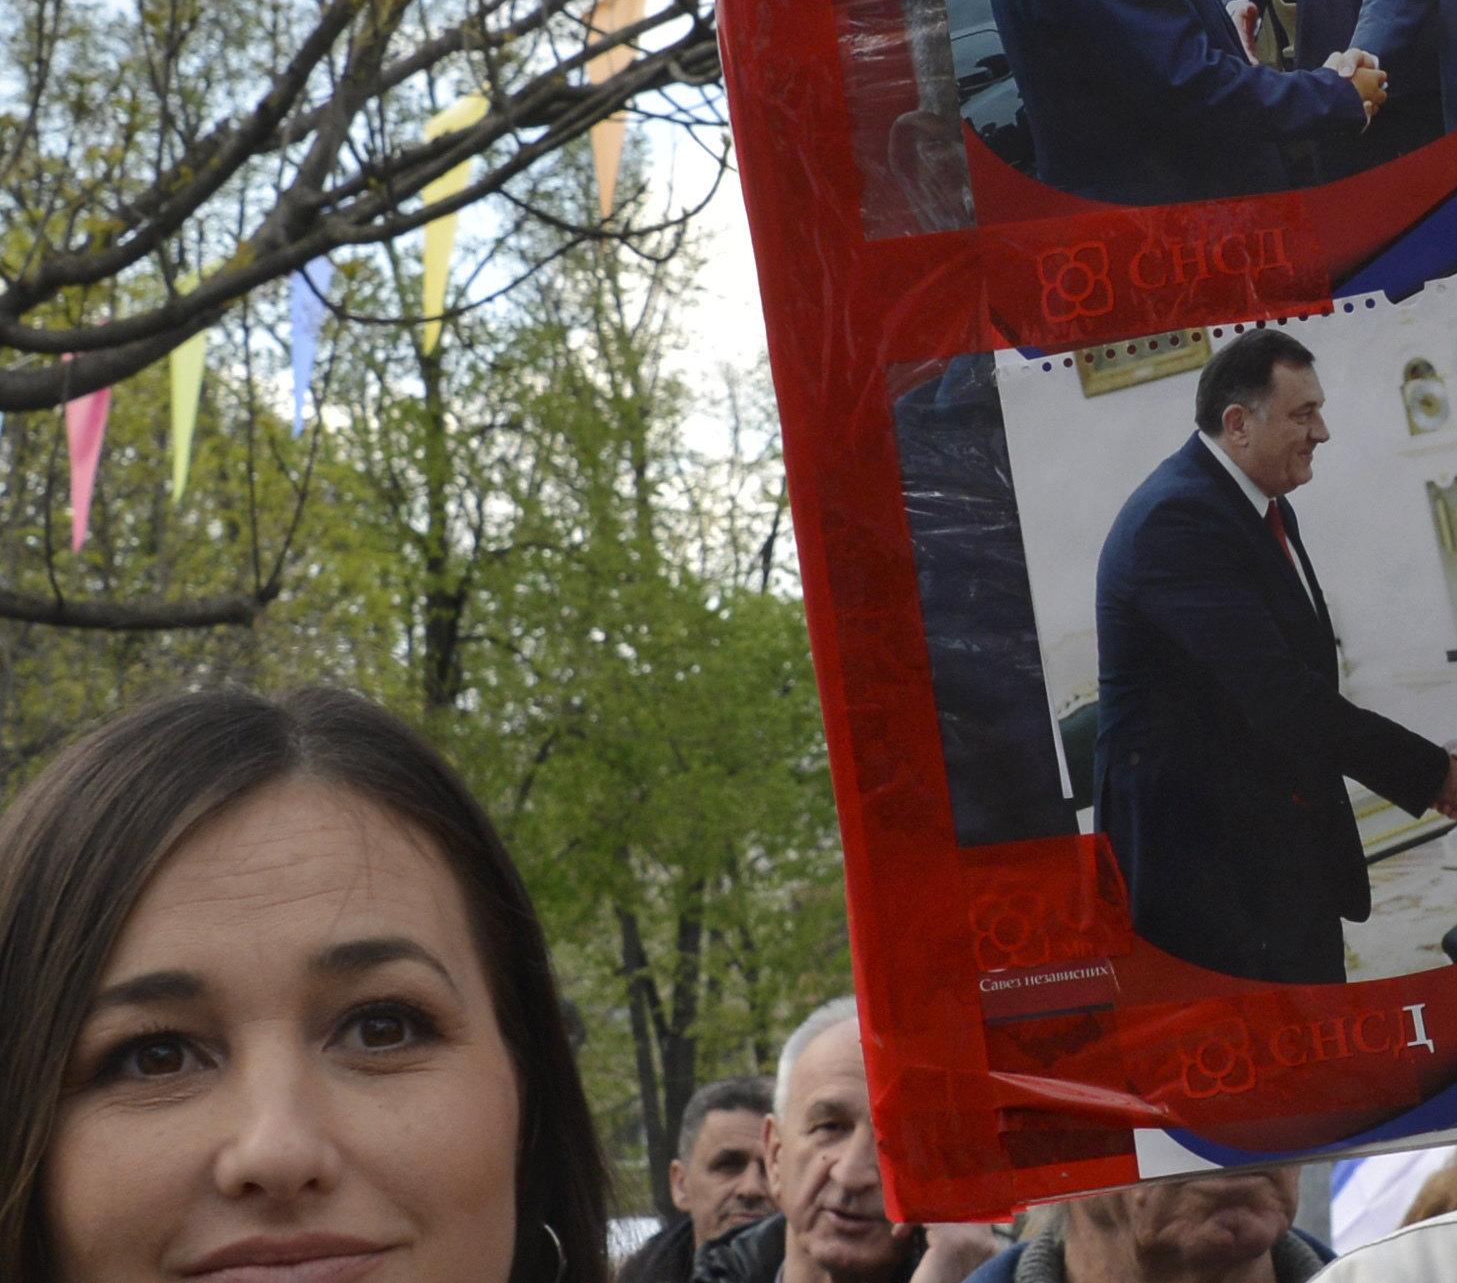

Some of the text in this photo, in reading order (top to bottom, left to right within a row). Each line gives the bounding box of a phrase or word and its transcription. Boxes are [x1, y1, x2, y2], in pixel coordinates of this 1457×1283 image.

[1129, 227, 1294, 289] СНСД
[979, 965, 1109, 993] Савез независних
[1270, 1003, 1435, 1067] СНСД
